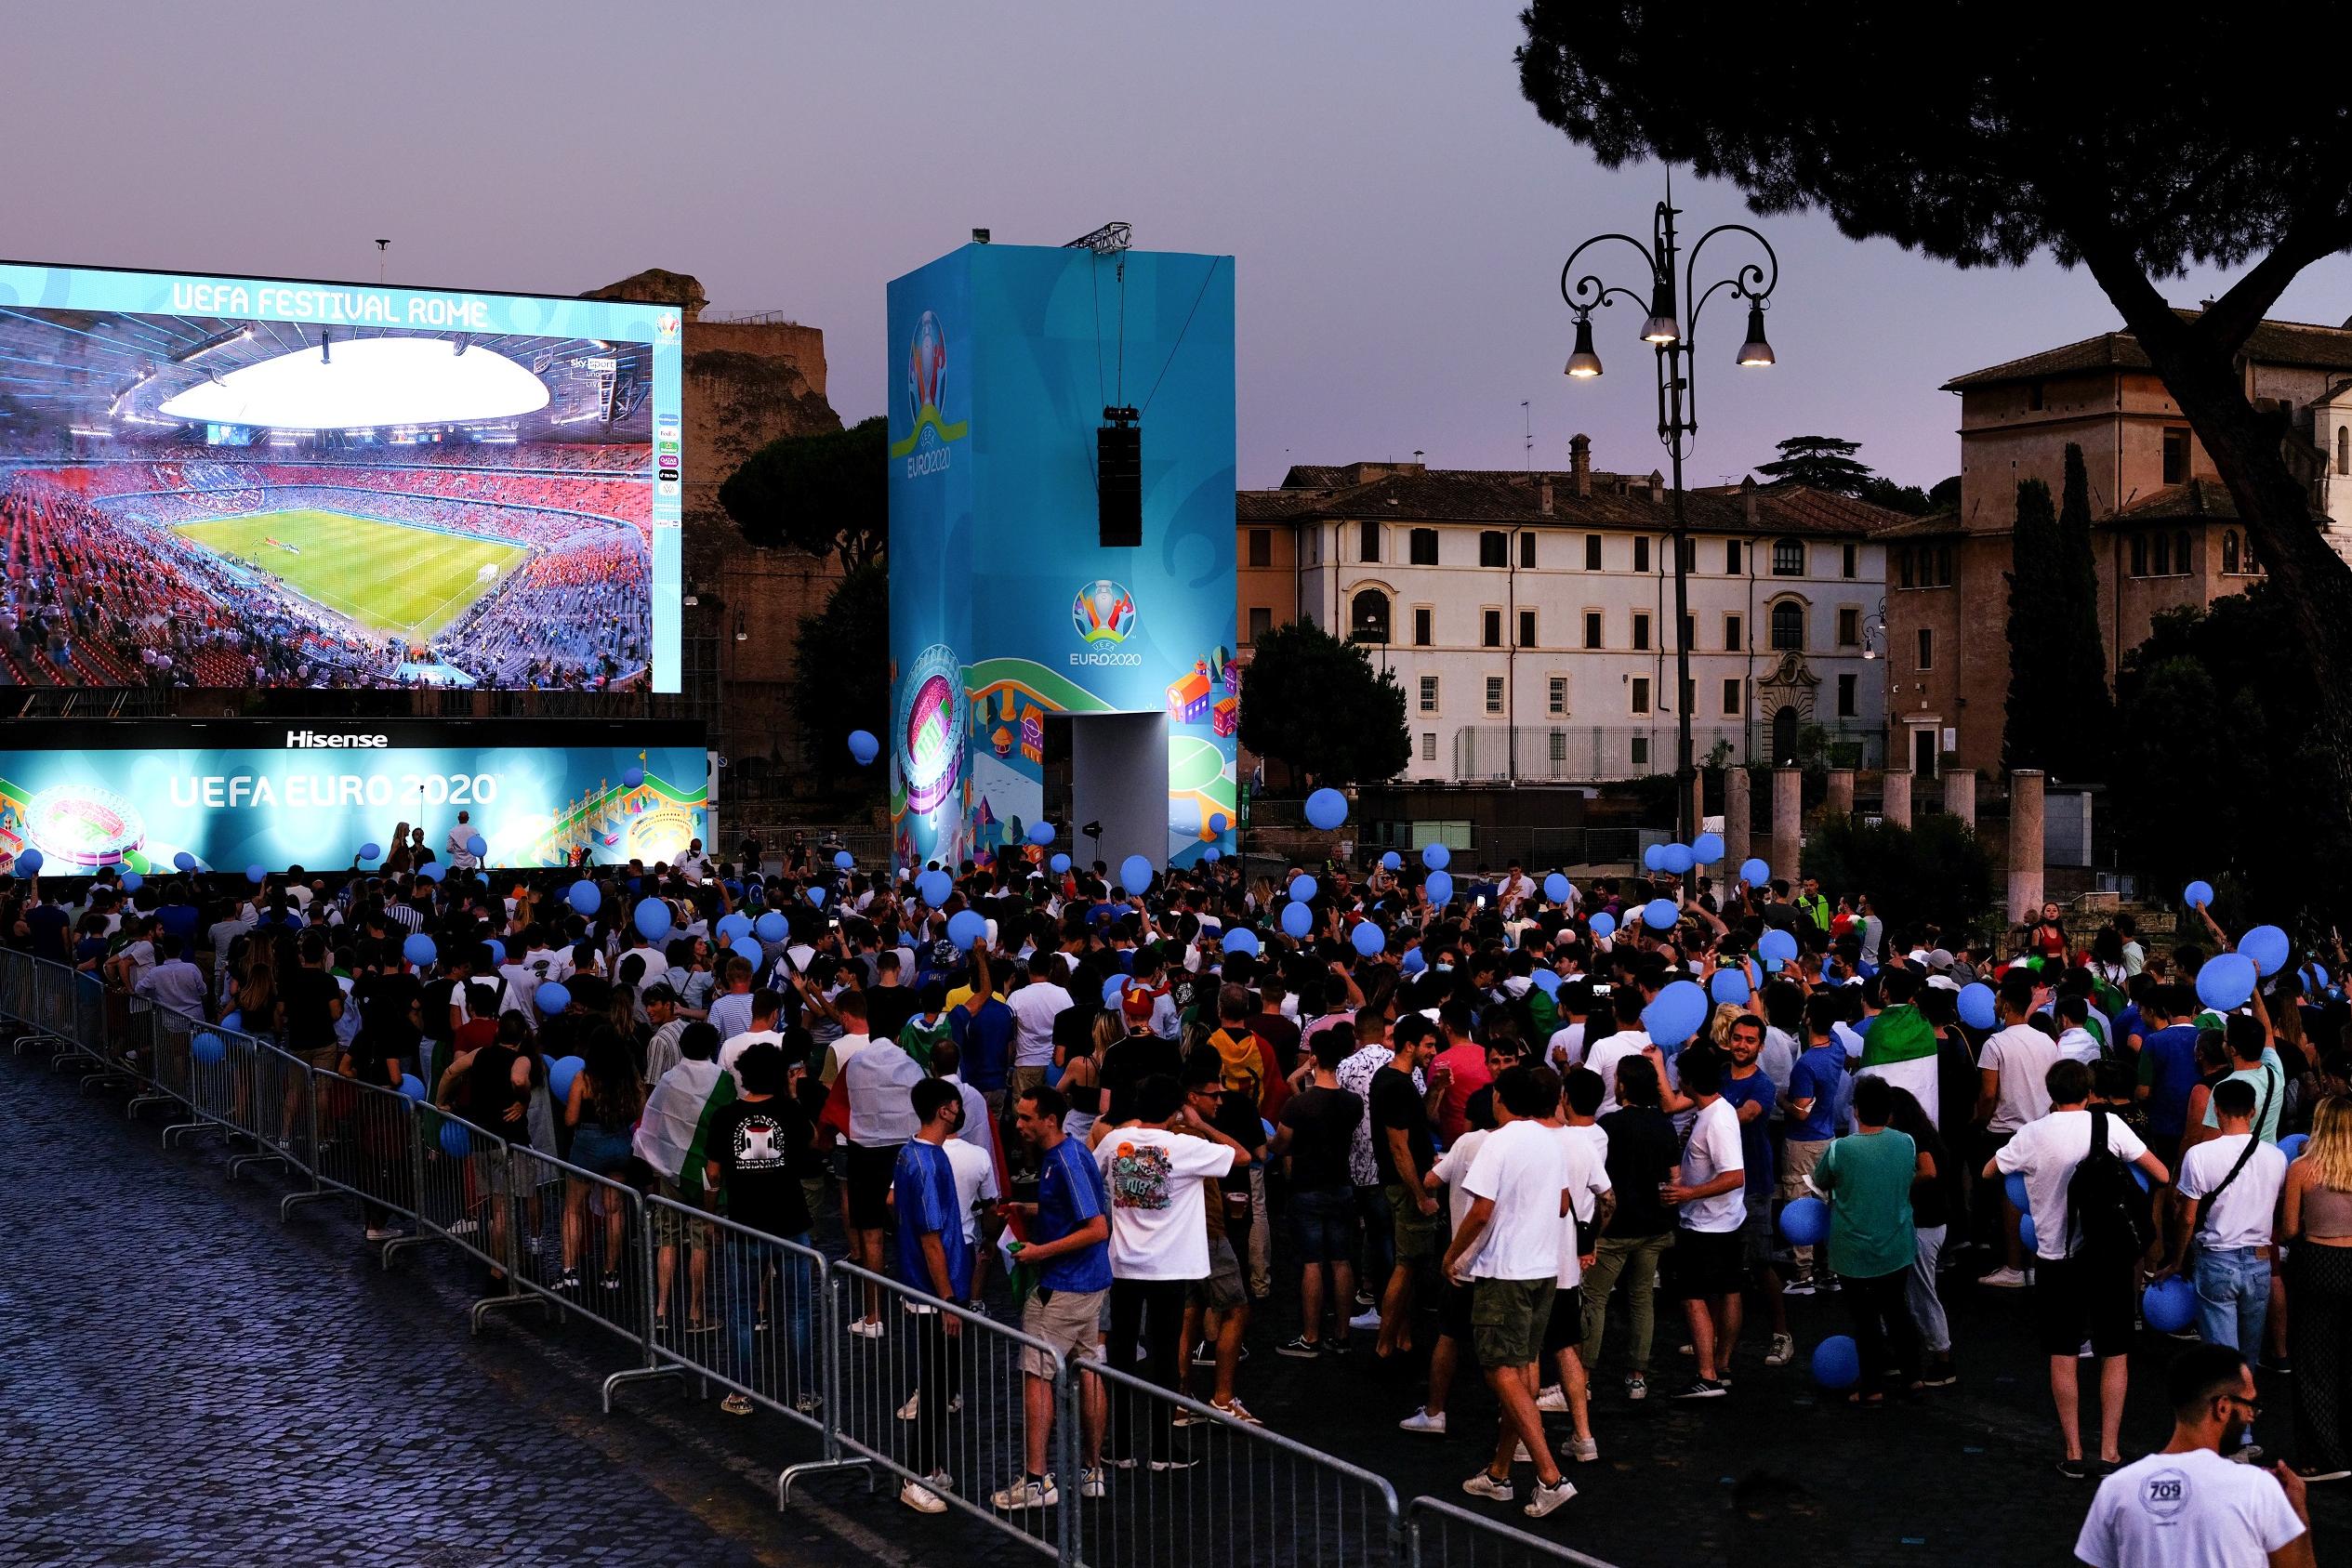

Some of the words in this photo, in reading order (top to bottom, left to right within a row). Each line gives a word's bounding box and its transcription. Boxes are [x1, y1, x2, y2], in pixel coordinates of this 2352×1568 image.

[172, 283, 250, 313] UEFA
[258, 288, 401, 323] FESTIVAL
[407, 296, 489, 328] ROME
[570, 358, 588, 368] sky
[907, 446, 951, 480] EURO2020
[1092, 642, 1115, 651] UEFA
[1069, 652, 1142, 665] EURO2020
[286, 731, 389, 748] Hisense
[169, 775, 278, 808] UEFA
[284, 774, 394, 807] EURO
[2149, 1483, 2181, 1498] 709
